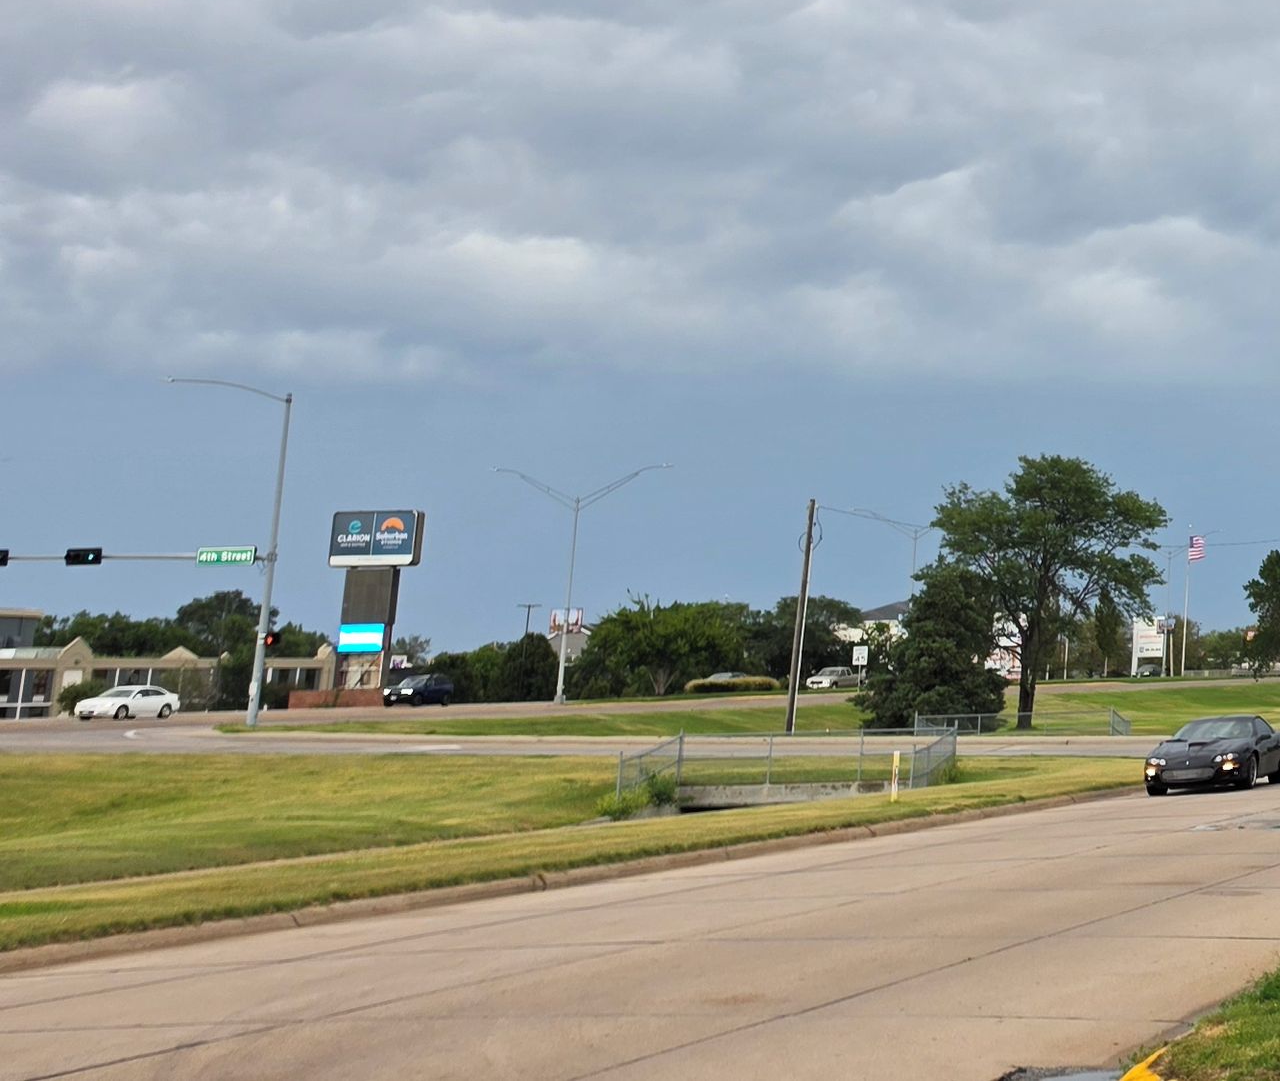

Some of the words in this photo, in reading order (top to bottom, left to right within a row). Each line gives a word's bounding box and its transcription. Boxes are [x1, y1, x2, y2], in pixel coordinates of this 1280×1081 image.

[337, 534, 371, 543] CLARION
[199, 551, 218, 562] 4th
[221, 551, 252, 562] Street
